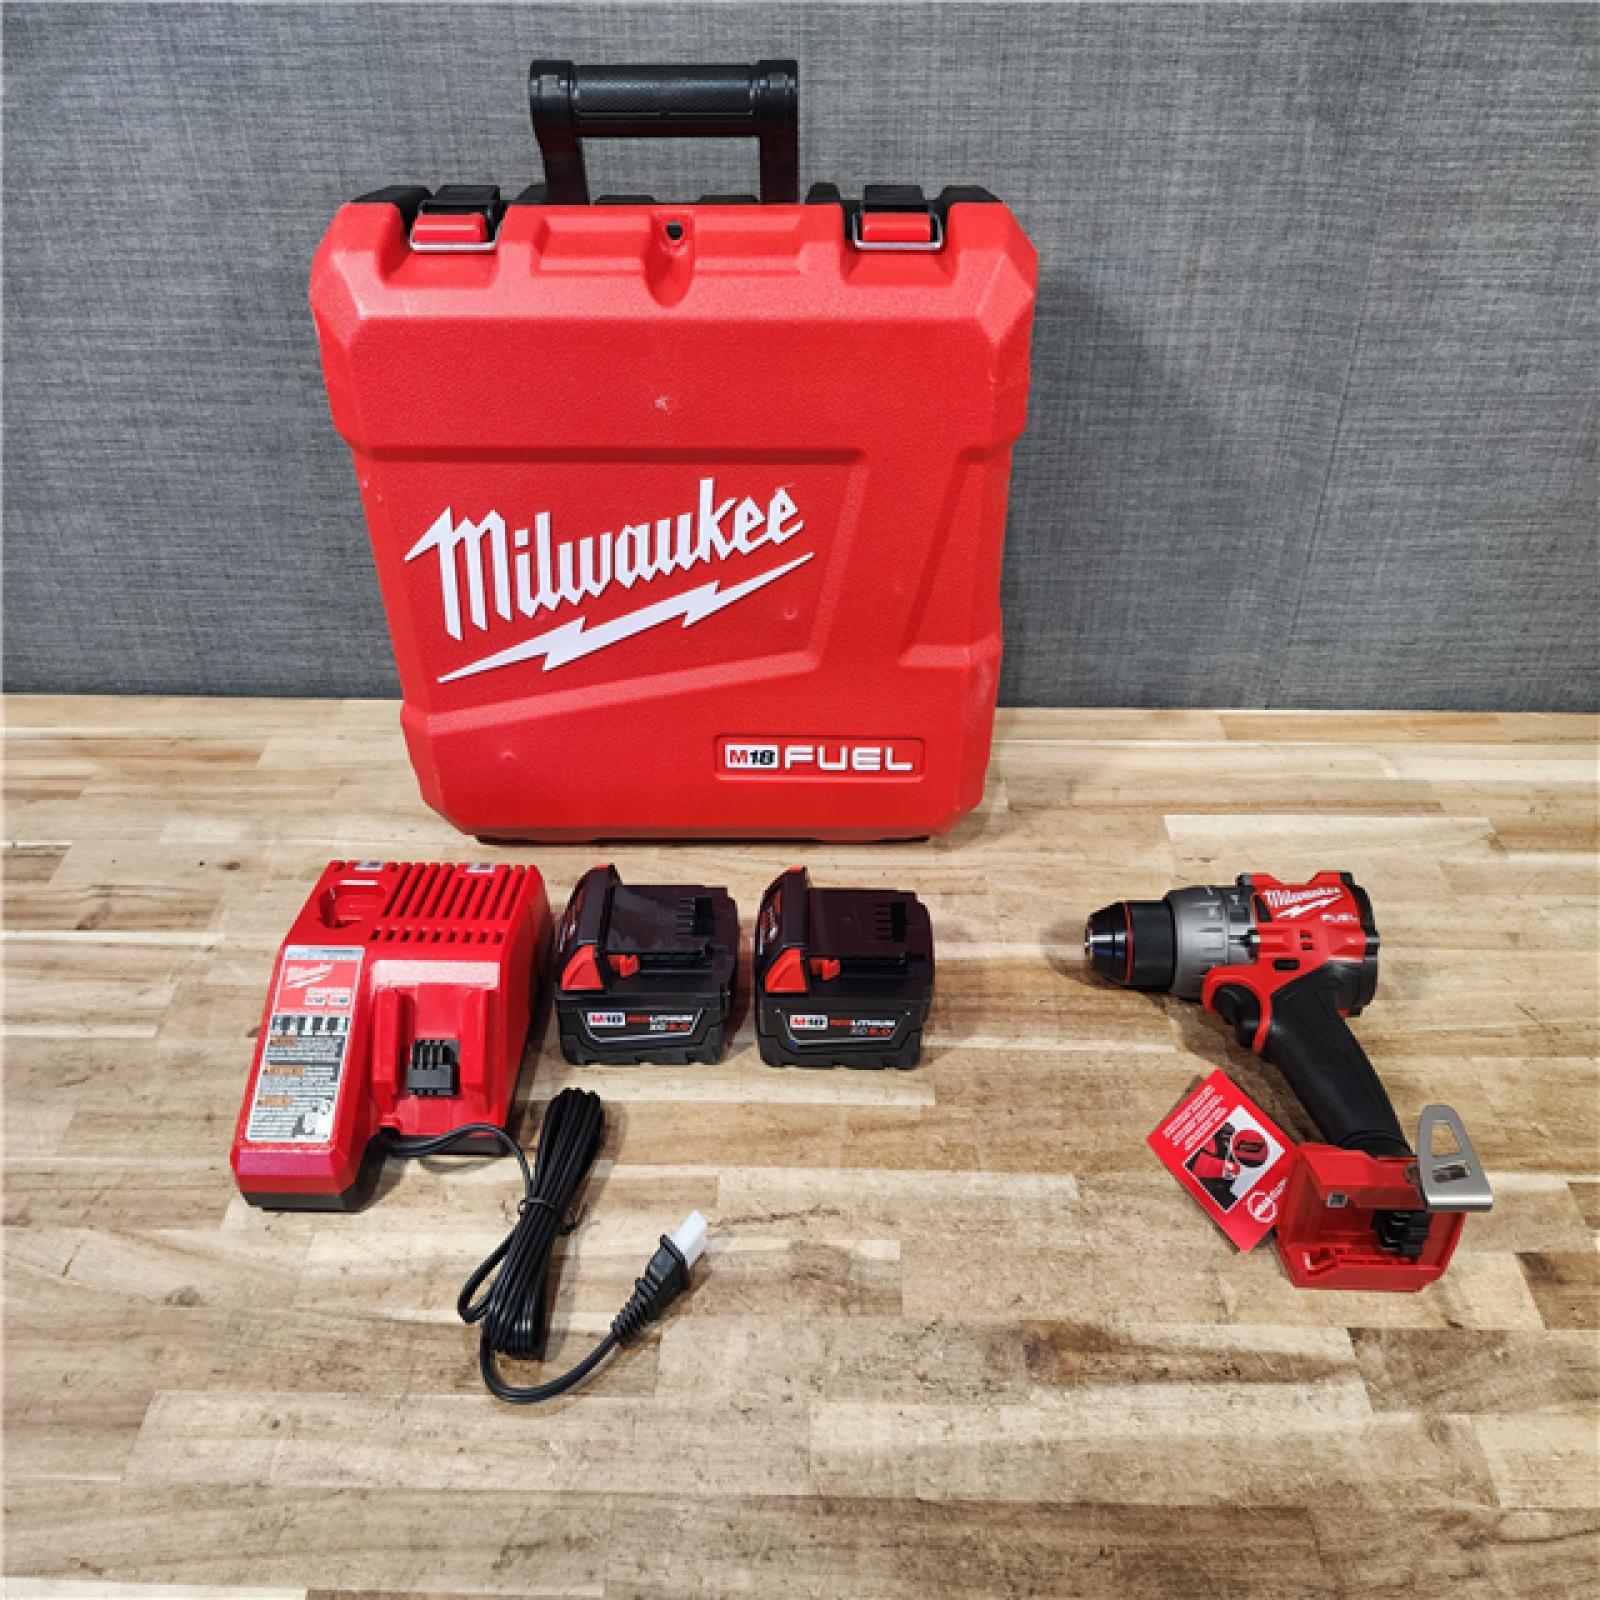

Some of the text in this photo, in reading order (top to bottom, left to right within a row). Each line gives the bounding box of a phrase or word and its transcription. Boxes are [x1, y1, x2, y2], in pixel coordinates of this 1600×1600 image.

[404, 477, 803, 641] Milwaukee
[728, 745, 913, 771] M18 FUEL
